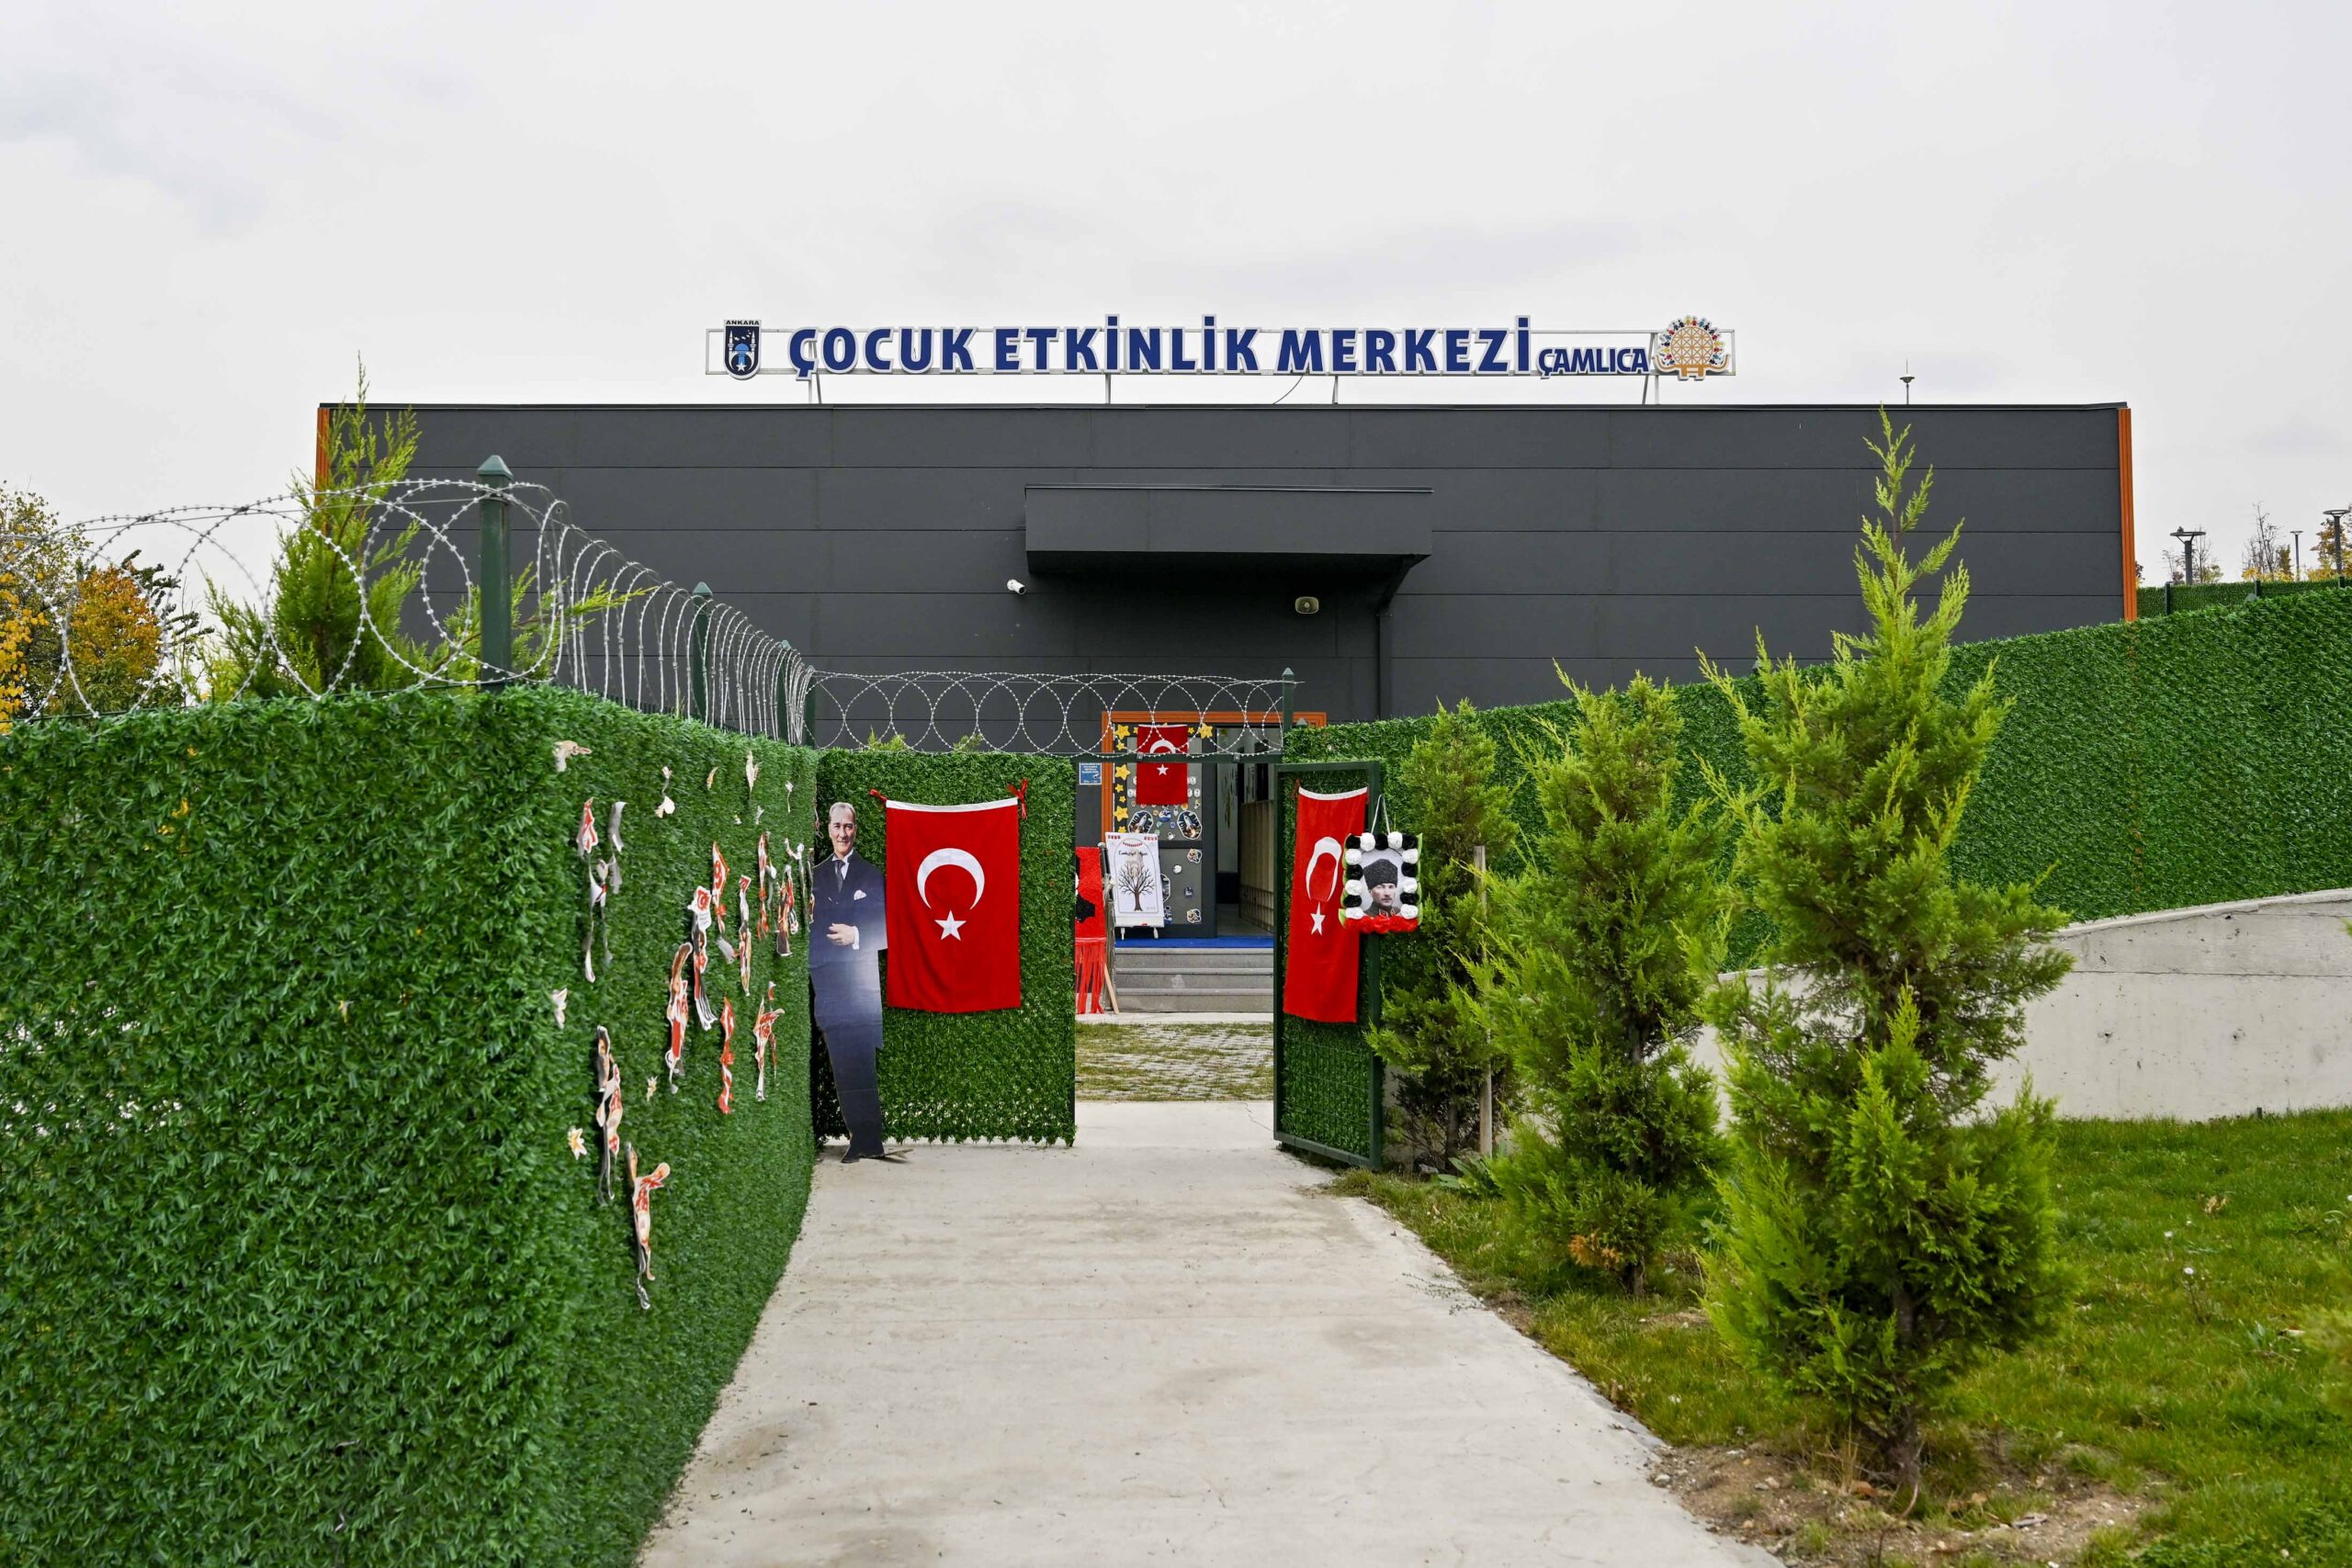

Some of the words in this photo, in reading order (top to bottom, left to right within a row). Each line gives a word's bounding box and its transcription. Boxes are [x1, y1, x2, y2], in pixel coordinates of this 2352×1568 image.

[790, 328, 974, 378] ÇOCUK
[996, 316, 1260, 372] ETKİNLİK
[1277, 317, 1530, 372] MERKEZİ
[1539, 348, 1650, 377] ÇAMLICA
